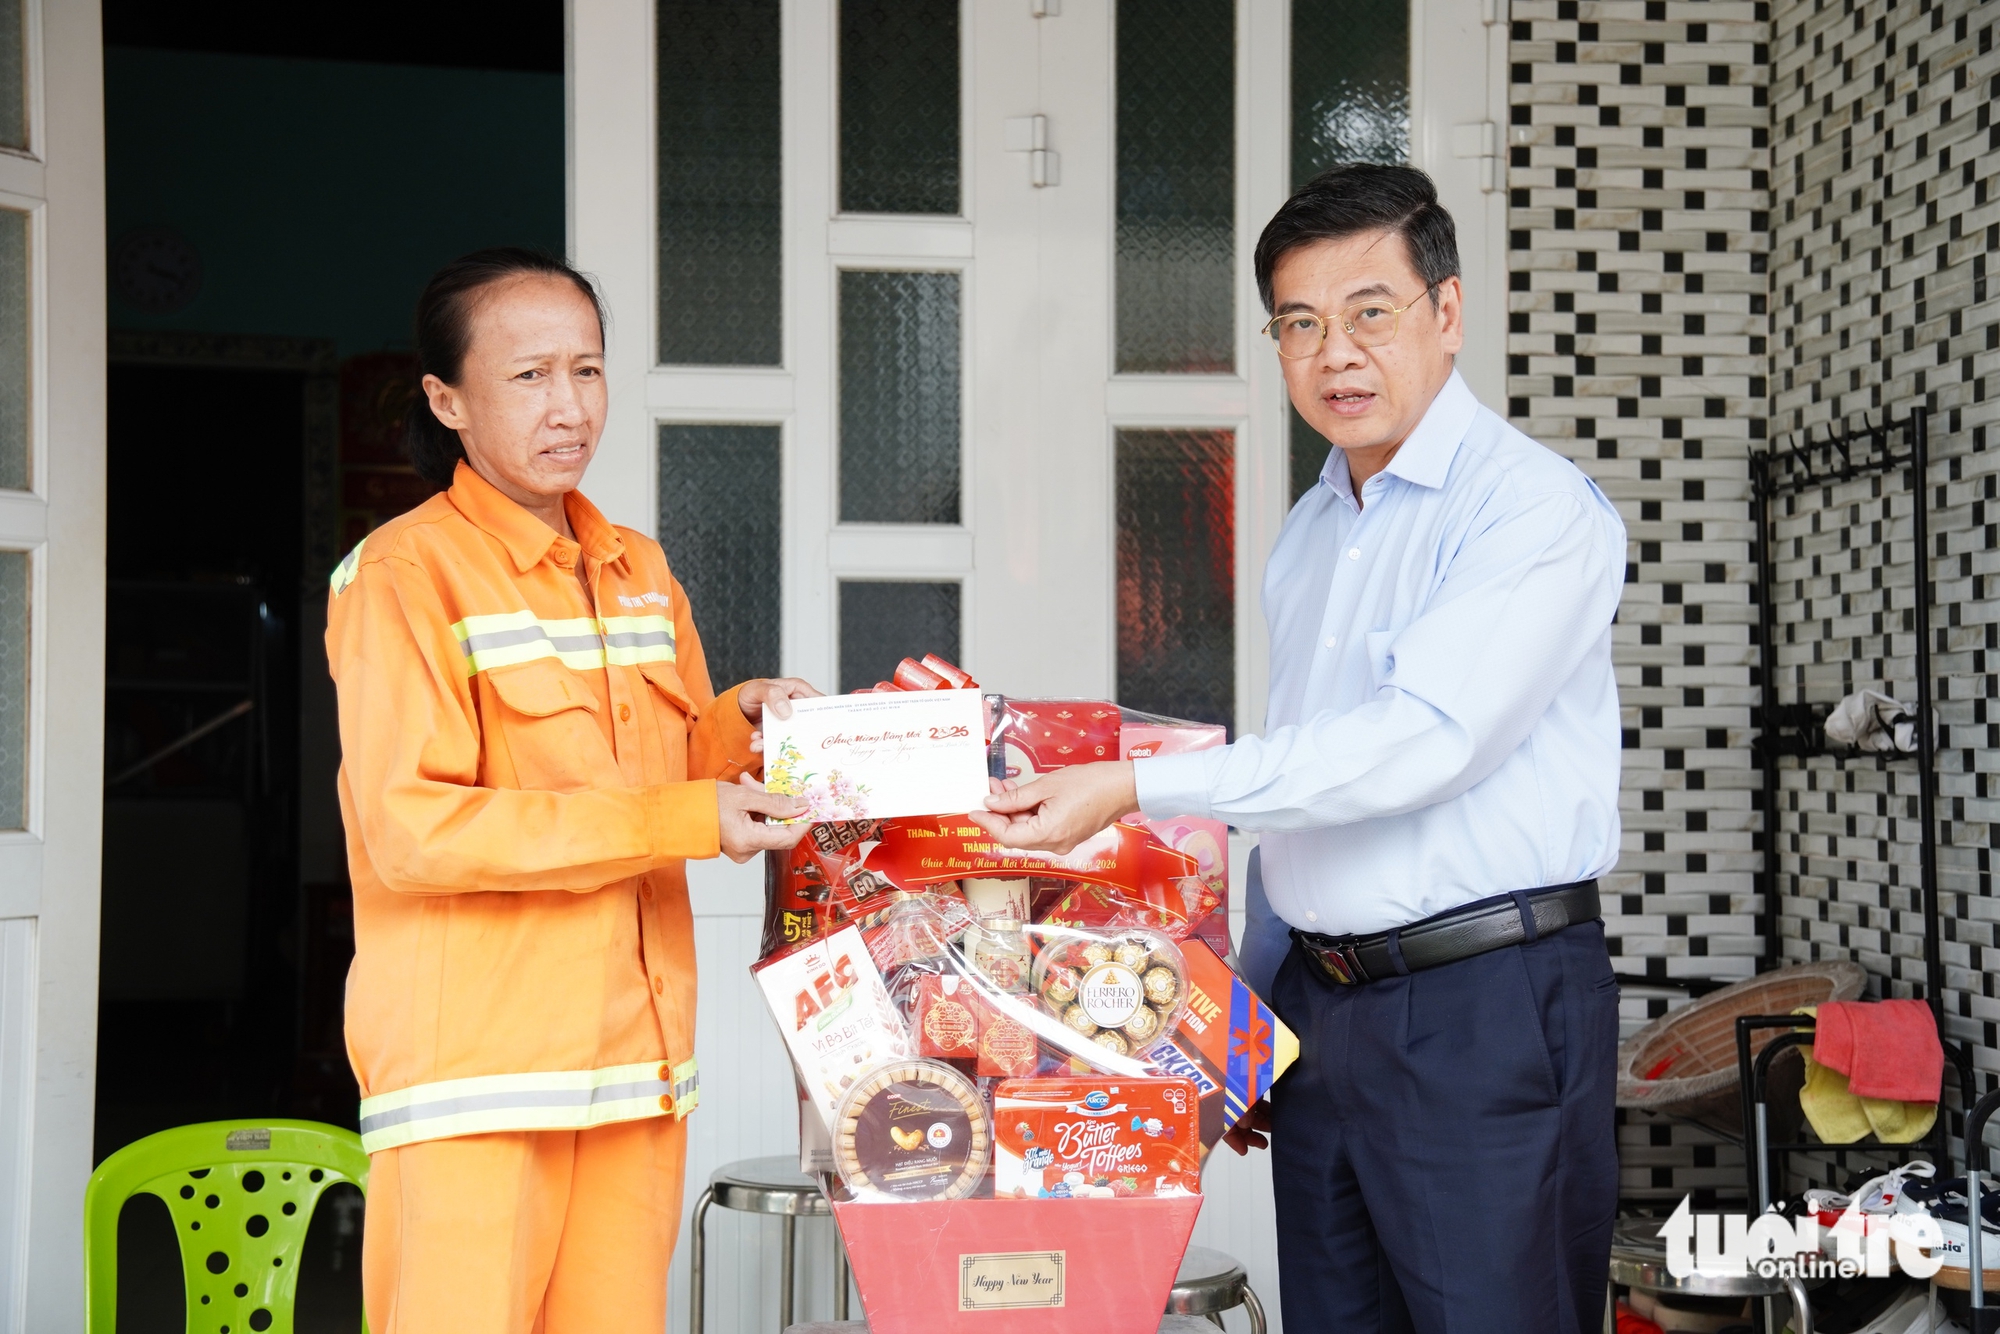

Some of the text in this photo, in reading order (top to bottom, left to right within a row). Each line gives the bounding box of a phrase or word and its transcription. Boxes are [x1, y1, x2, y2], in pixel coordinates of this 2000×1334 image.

[957, 826, 981, 837] HĐND
[921, 857, 943, 868] Chúc
[945, 857, 971, 870] Mừng
[976, 857, 998, 869] Năm
[1000, 857, 1018, 869] Mới
[1096, 858, 1116, 869] 2026
[793, 953, 860, 1032] AFC
[1087, 987, 1135, 998] FERRERO
[1087, 998, 1135, 1009] ROCHER
[1188, 980, 1222, 1024] TIVE
[1182, 1007, 1208, 1035] TION
[1150, 1045, 1214, 1094] CKERS
[1054, 1121, 1120, 1160] Butter
[1080, 1142, 1142, 1177] Toffees
[972, 1272, 1053, 1292] Happy New Year
